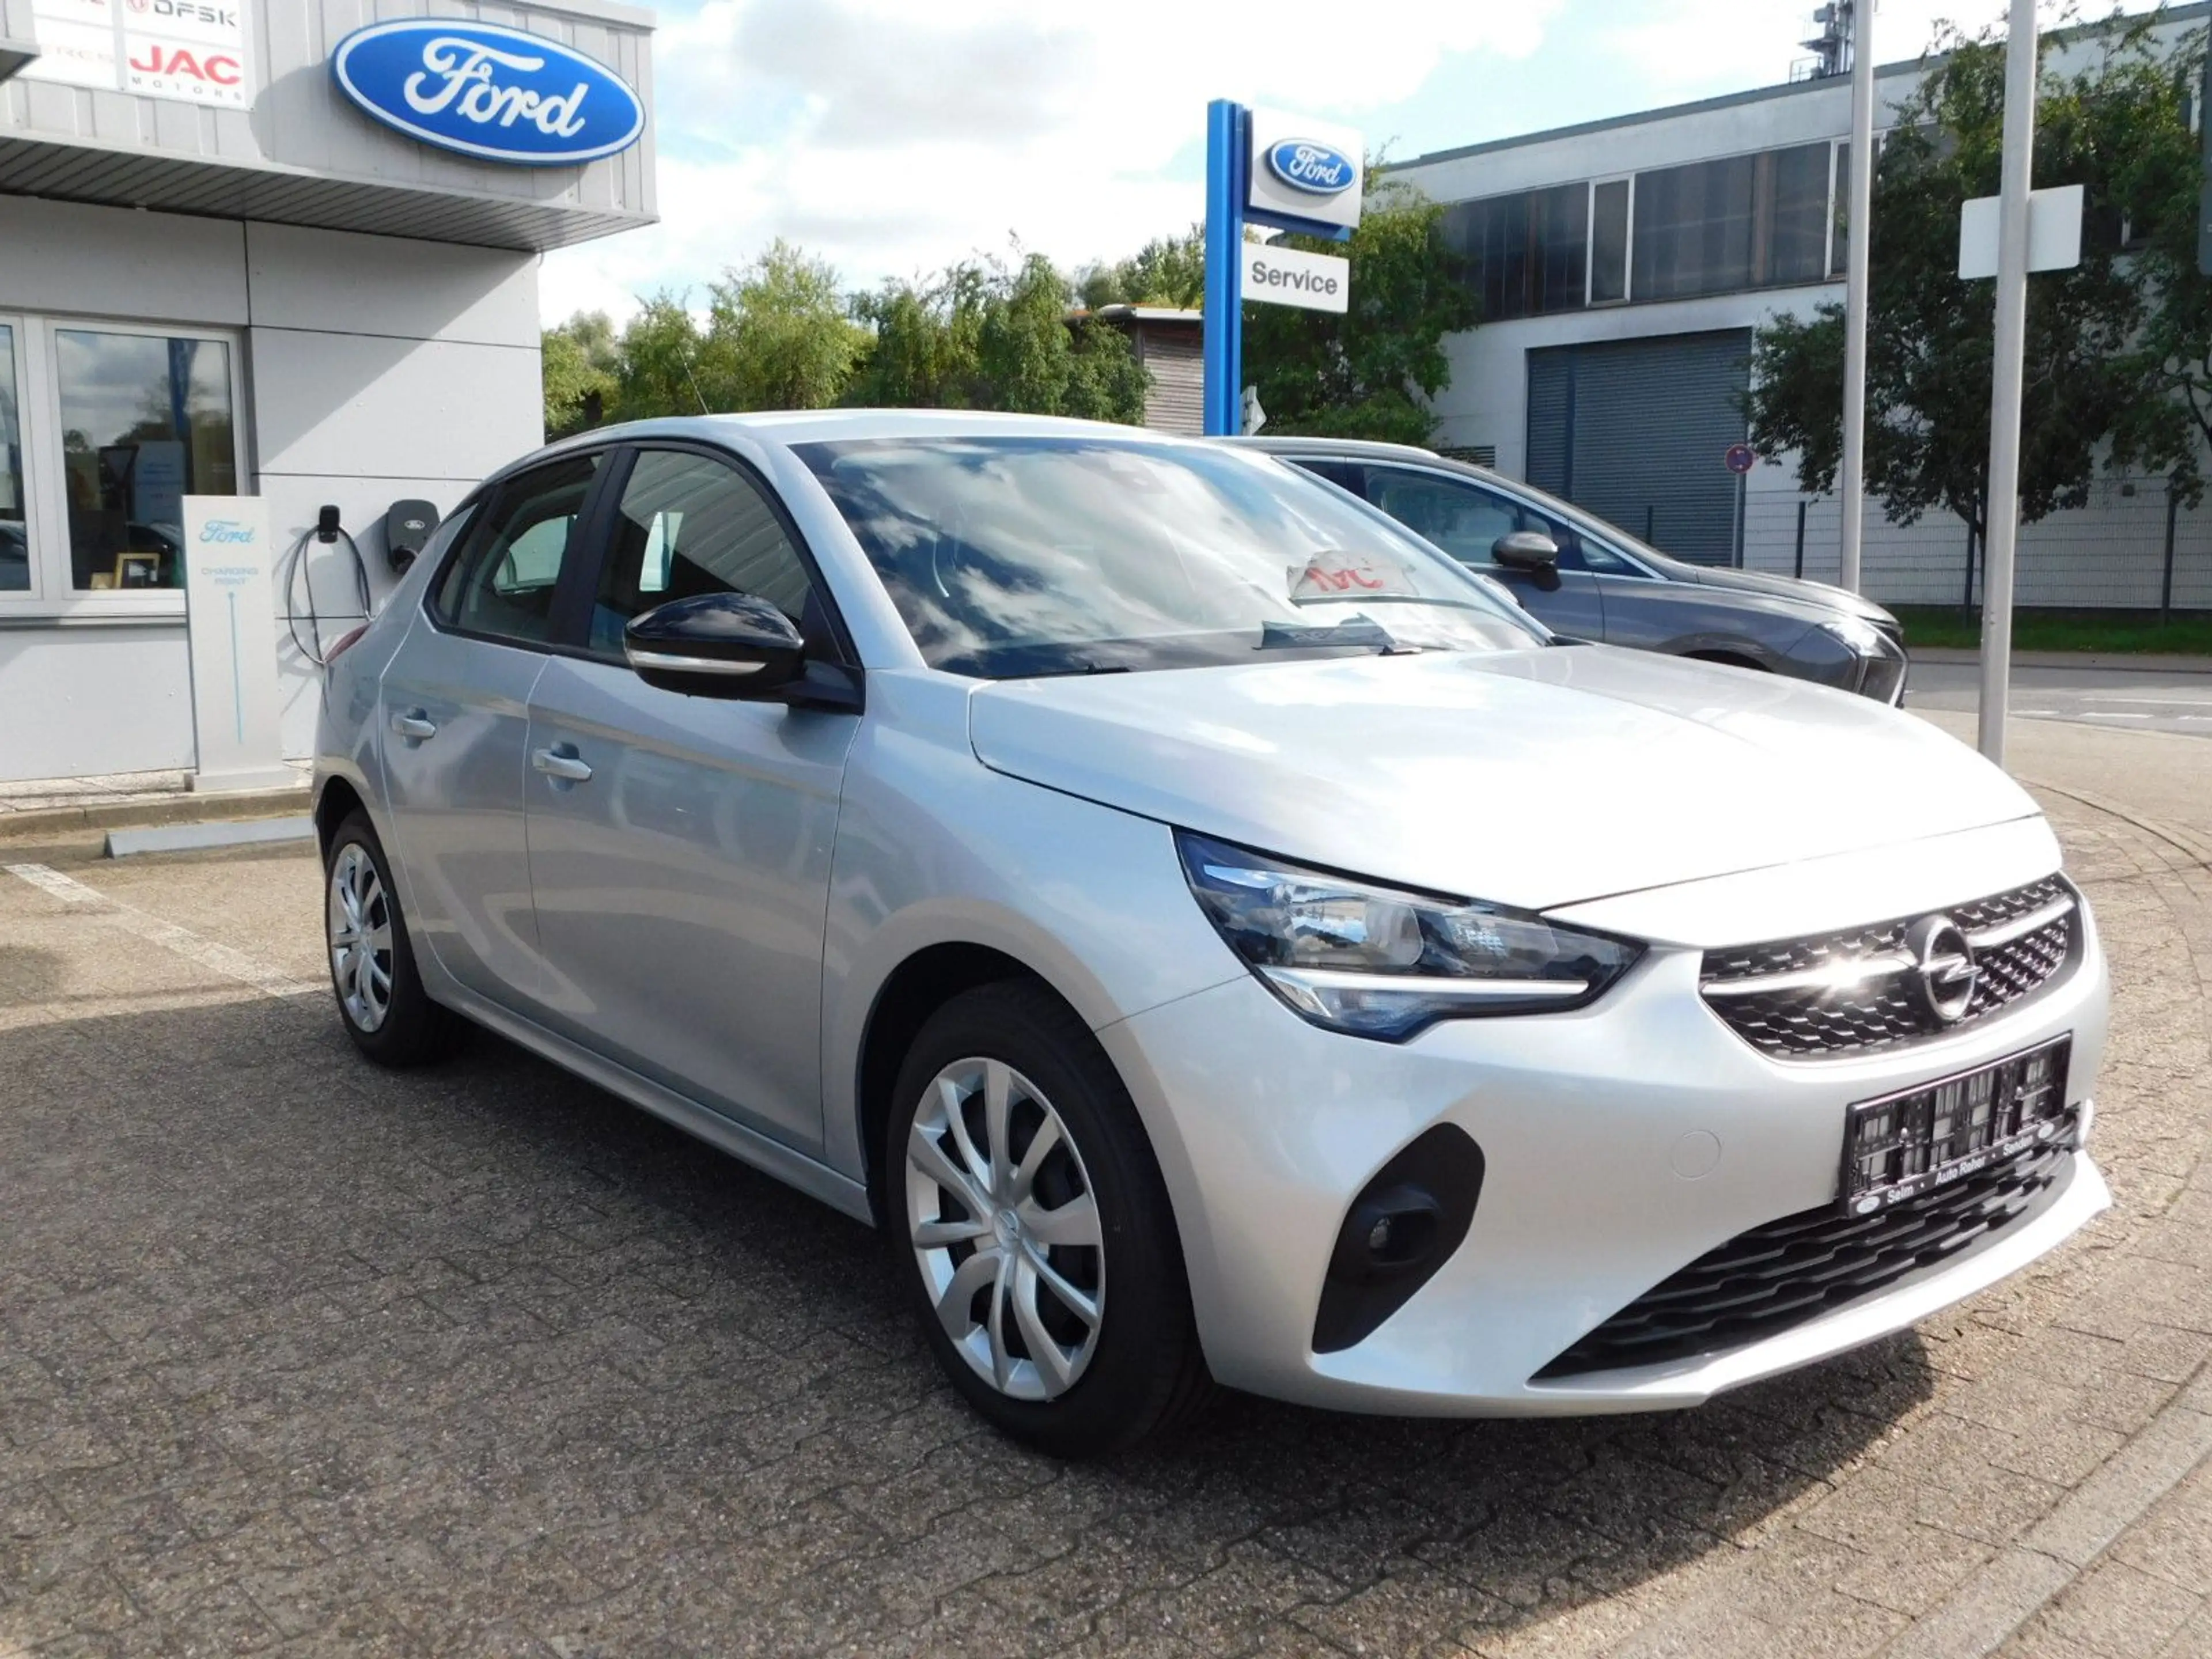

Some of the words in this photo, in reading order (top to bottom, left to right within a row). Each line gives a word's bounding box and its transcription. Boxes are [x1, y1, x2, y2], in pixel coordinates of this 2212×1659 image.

[130, 46, 241, 85] JAC
[131, 75, 243, 100] MOTORS
[404, 37, 589, 138] Ford
[1290, 146, 1341, 184] Ford
[1252, 261, 1338, 295] Service
[199, 520, 255, 543] Ford
[200, 567, 259, 575] CHARGING
[1935, 1166, 1958, 1185] Auto
